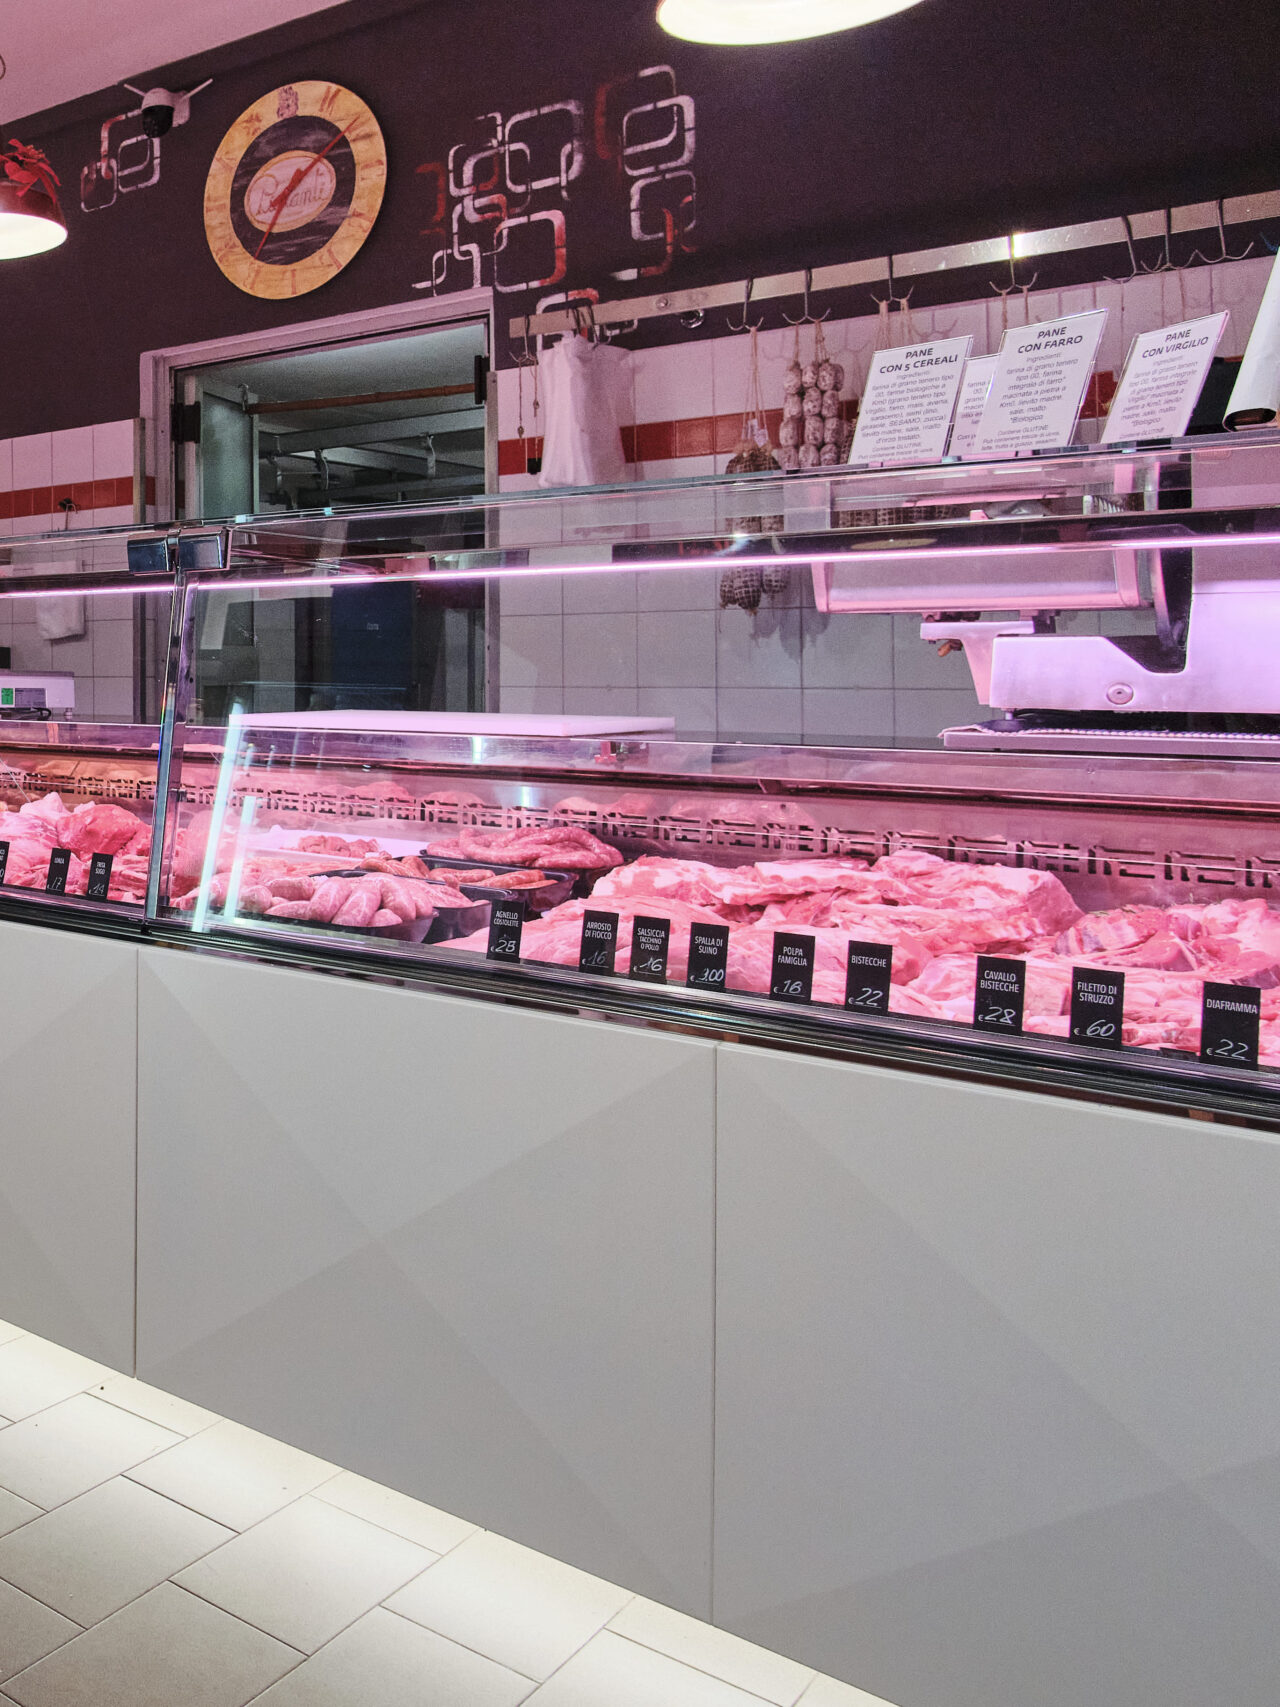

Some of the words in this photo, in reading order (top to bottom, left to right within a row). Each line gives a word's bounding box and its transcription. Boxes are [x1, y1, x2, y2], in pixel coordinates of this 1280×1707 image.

[1037, 327, 1067, 338] PANE
[1165, 329, 1191, 342] PANE
[1018, 343, 1042, 353] CON
[1044, 336, 1083, 349] FARRO
[1142, 347, 1163, 358] CON
[1166, 337, 1208, 353] VIRGILIO
[905, 348, 933, 359] PANE
[880, 364, 902, 373] CON
[913, 354, 958, 368] CEREALI
[495, 910, 519, 920] AGNELLO
[586, 921, 612, 931] ARROSTO
[584, 929, 591, 938] DI
[591, 930, 612, 940] FIOCCO
[637, 928, 665, 938] SALSICCIA
[639, 936, 662, 945] TACCHINO
[645, 943, 659, 951] POLLO
[694, 935, 715, 947] SPALLA
[716, 939, 723, 947] DI
[698, 945, 718, 955] SUINO
[783, 946, 803, 957] POLPA
[777, 954, 807, 967] FAMIGLIA
[851, 955, 887, 968] BISTECCHE
[984, 970, 1016, 983] CAVALLO
[980, 980, 1020, 993] BISTECCHE
[1077, 981, 1106, 993] FILETTO
[1108, 985, 1117, 994] DI
[855, 987, 883, 1007] 22
[1079, 992, 1114, 1005] STRUZZO
[1206, 998, 1258, 1014] DIAFRAMMA
[984, 1006, 1016, 1024] 28
[1086, 1019, 1116, 1037] 60
[1214, 1038, 1249, 1059] 22
